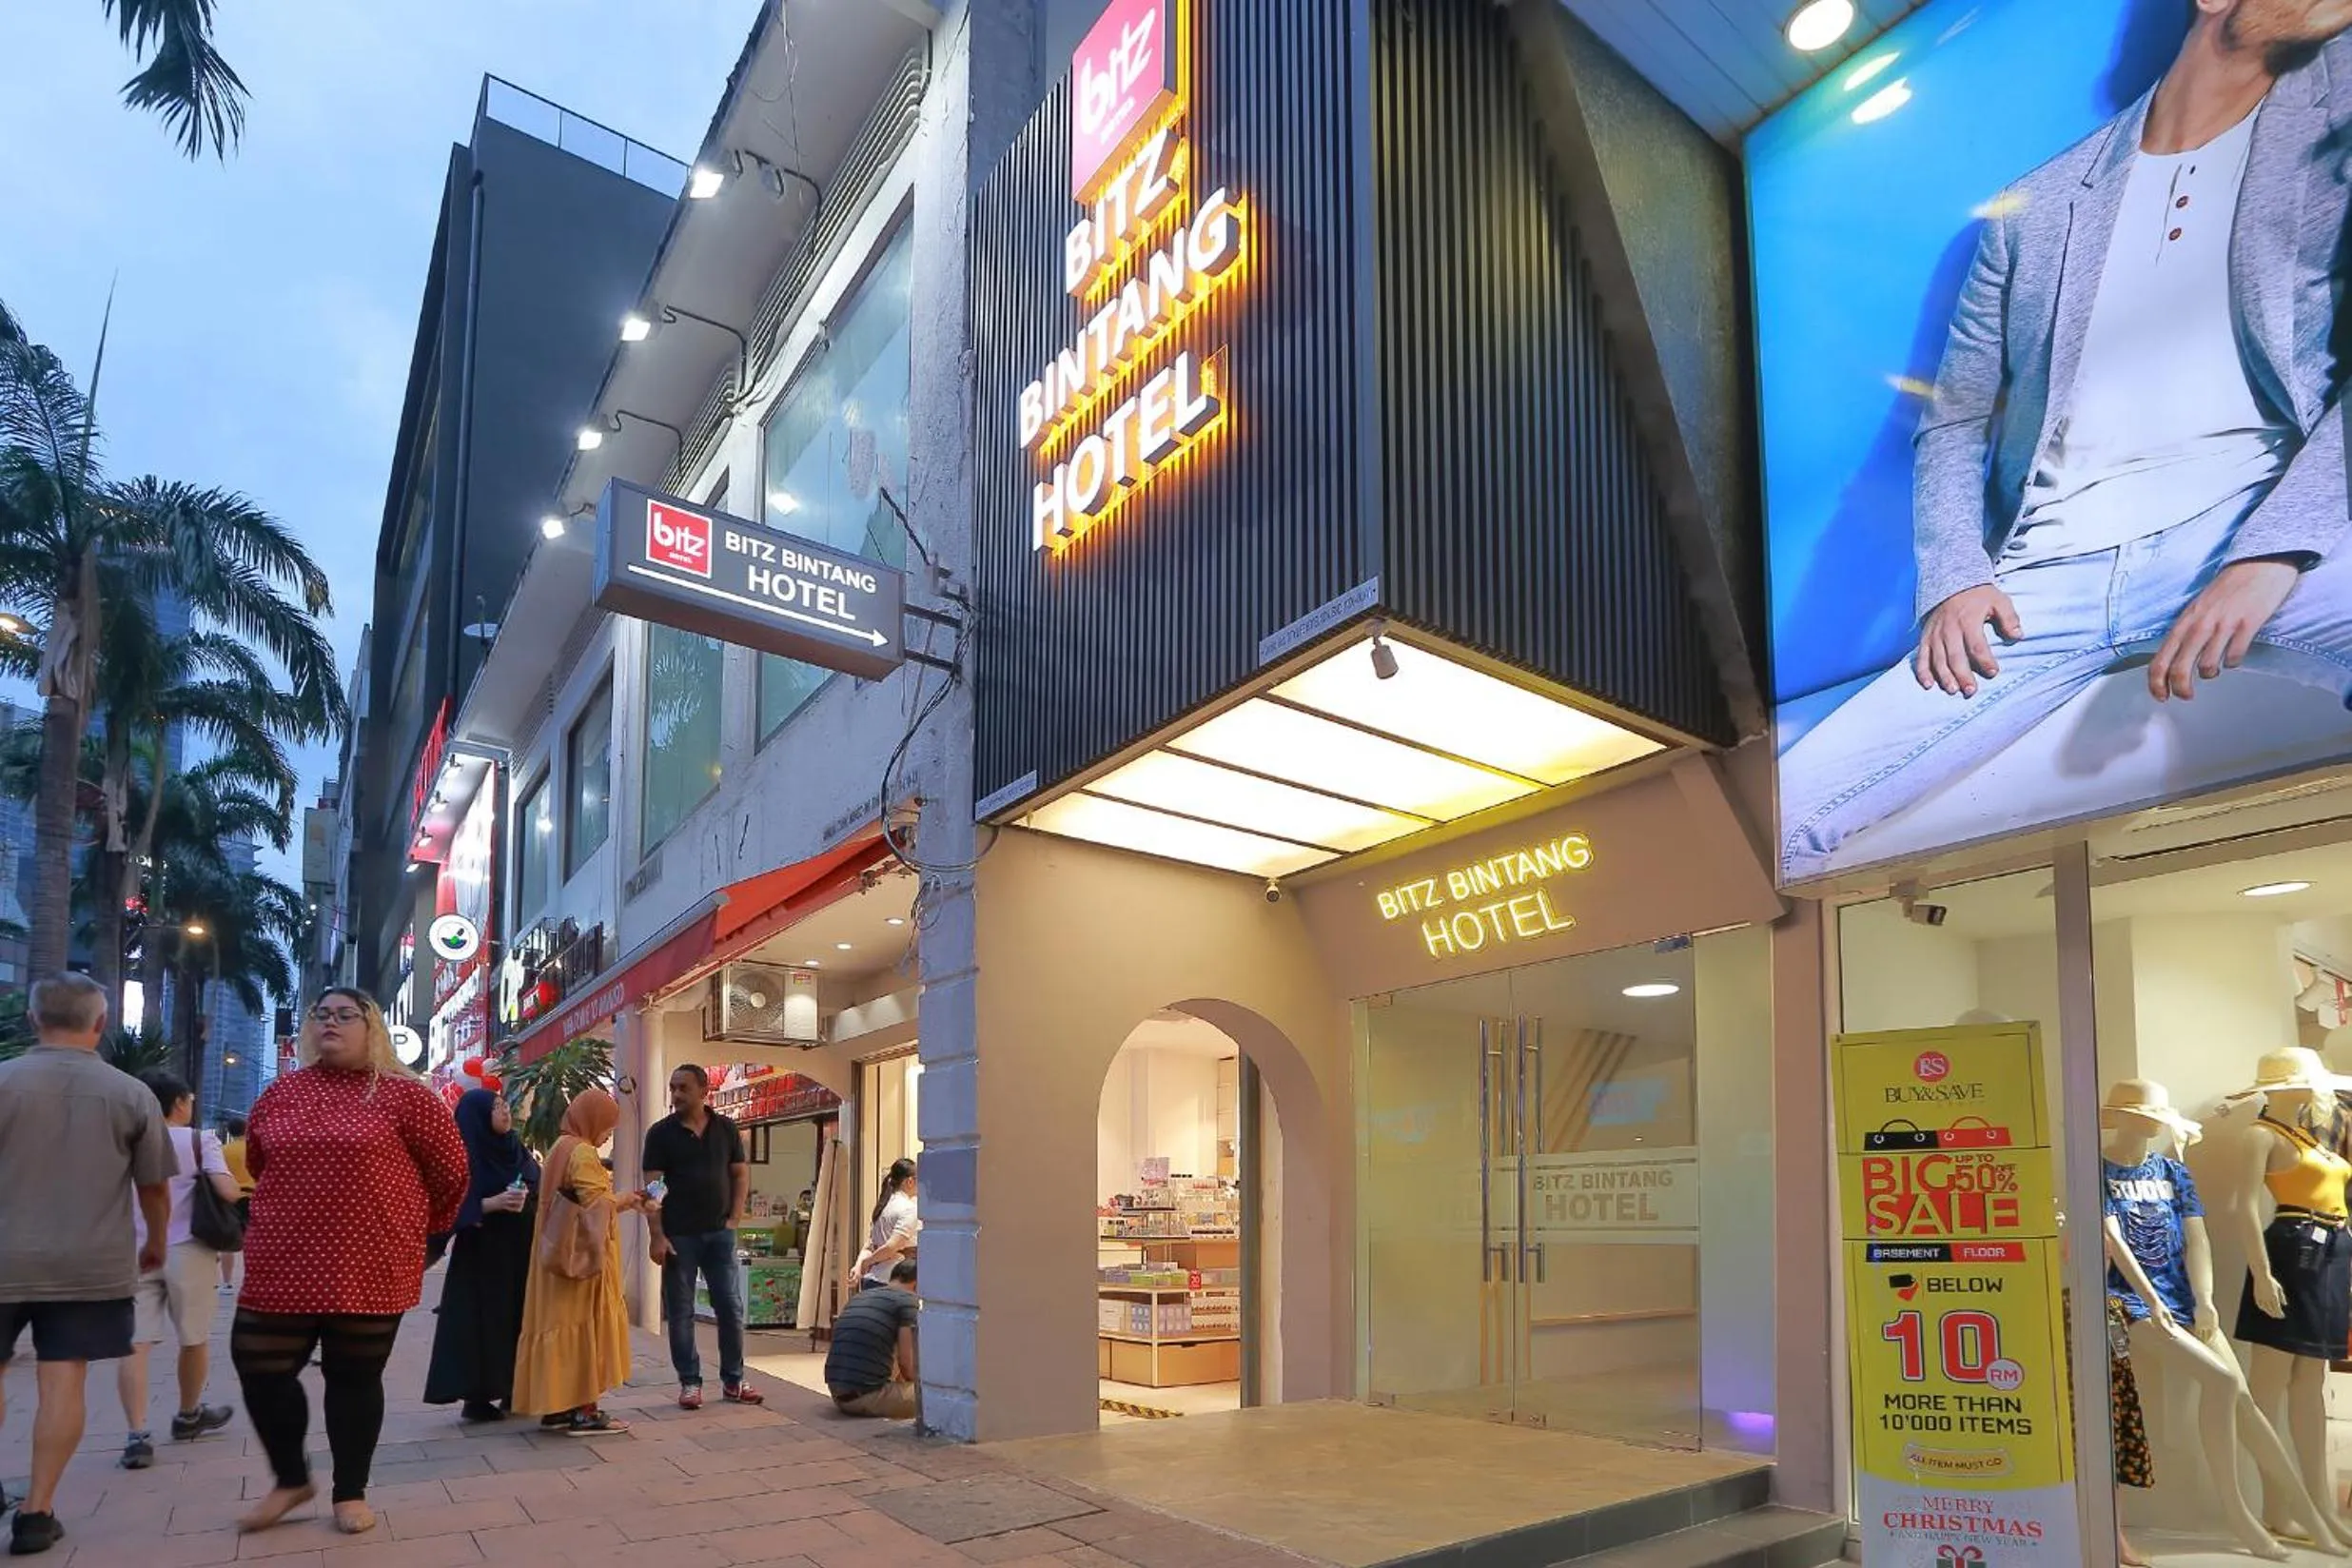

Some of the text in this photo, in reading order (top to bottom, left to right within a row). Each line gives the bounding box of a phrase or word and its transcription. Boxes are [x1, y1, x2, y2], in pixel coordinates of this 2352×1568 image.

[1079, 7, 1157, 136] bitz
[1066, 127, 1180, 295] BITZ
[1019, 186, 1245, 450] BINTANG
[1032, 350, 1214, 553] HOTEL
[653, 512, 705, 557] bitz
[725, 530, 877, 595] BITZ BINTANG
[747, 565, 856, 621] HOTEL
[1377, 833, 1594, 920] BITZ BINTANG
[1422, 889, 1576, 957] HOTEL
[1862, 1153, 1952, 1193] BIG
[1976, 1153, 1994, 1163] TO
[1534, 1168, 1674, 1190] BITZ BINTANG
[1545, 1192, 1659, 1221] HOTEL
[1867, 1193, 2019, 1235] SALE
[1872, 1246, 2006, 1259] BASEMENT FLOOR
[1927, 1277, 2004, 1293] BELOW
[1881, 1309, 2002, 1382] 10
[1989, 1368, 2019, 1382] RM
[1884, 1394, 2022, 1413] MORE THAN
[1959, 1416, 2032, 1435] ITEMS
[1883, 1512, 2043, 1539] CHRISTMAS
[1923, 1496, 1994, 1514] MERRY
